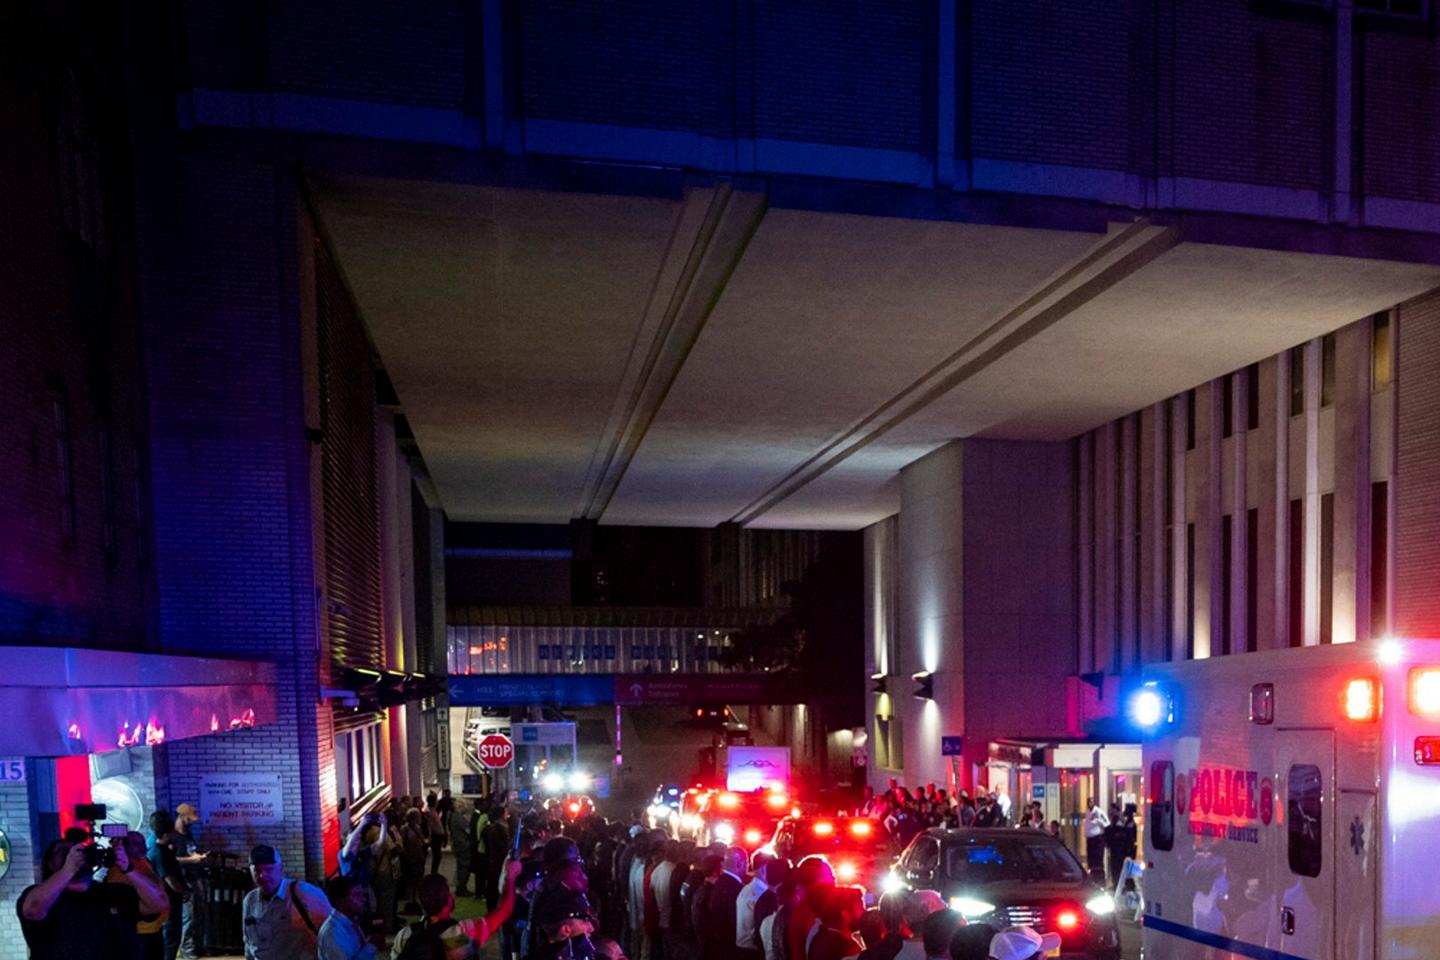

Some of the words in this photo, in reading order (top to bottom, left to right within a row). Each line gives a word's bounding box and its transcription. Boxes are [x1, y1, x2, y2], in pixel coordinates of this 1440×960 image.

[480, 743, 512, 759] STOP
[1187, 768, 1258, 820] POLICE
[1228, 823, 1258, 844] SERVICE
